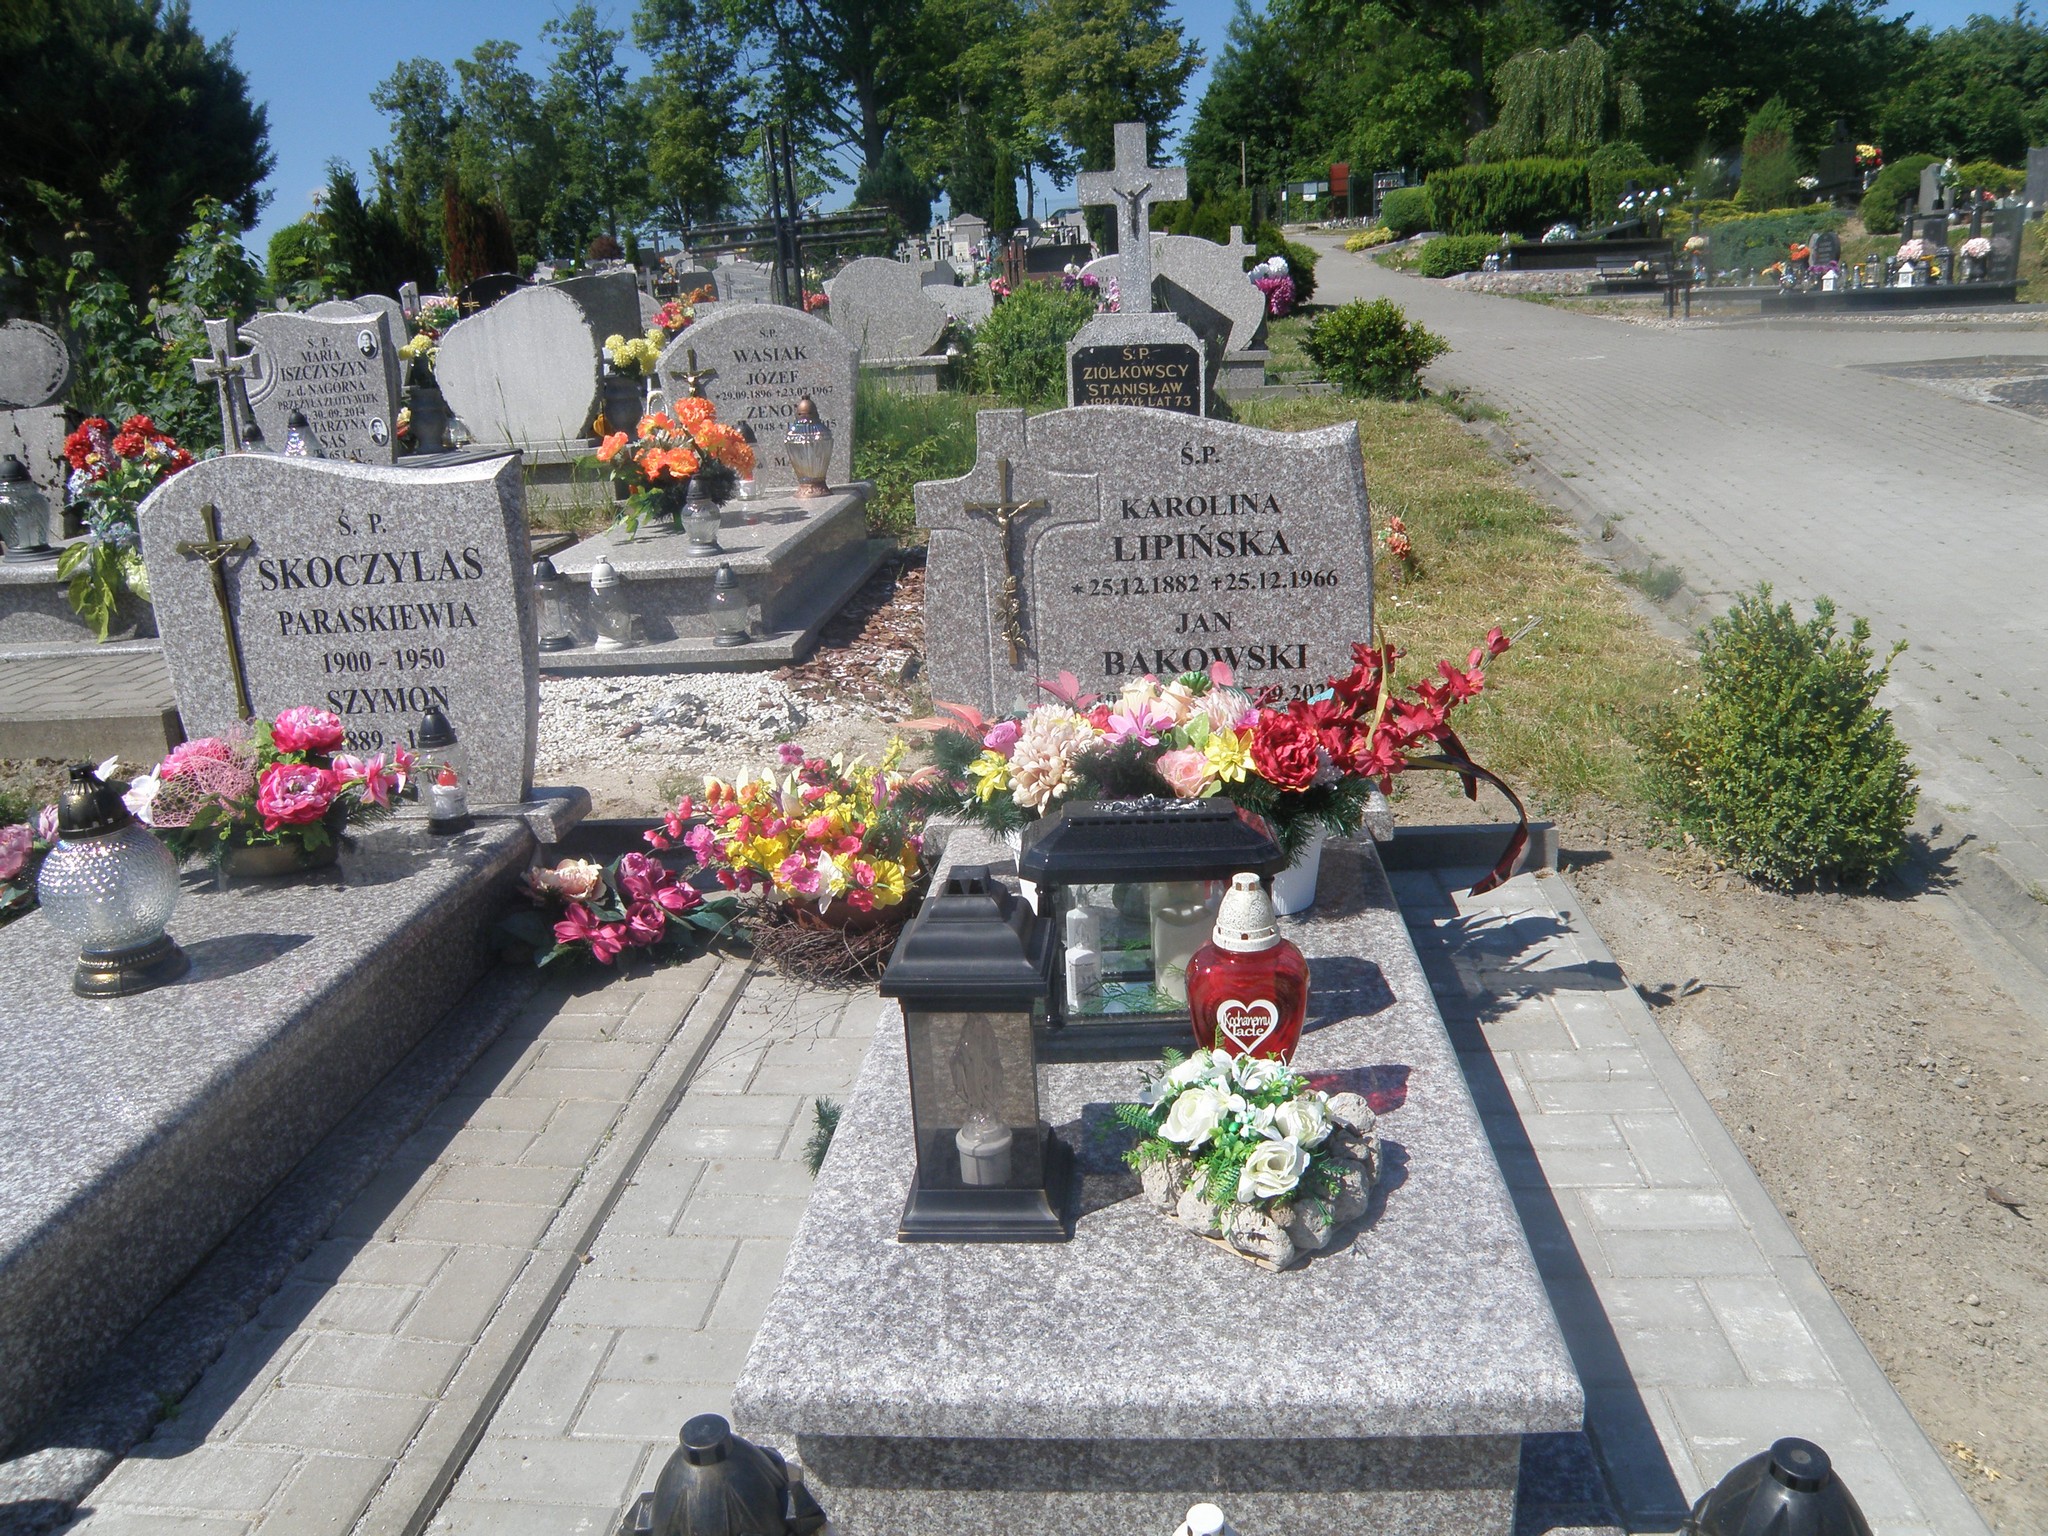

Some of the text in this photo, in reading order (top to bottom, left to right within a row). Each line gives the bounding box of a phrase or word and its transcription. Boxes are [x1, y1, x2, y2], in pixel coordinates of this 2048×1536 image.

[301, 350, 341, 363] MARIA
[733, 346, 808, 363] WASIAK
[281, 361, 367, 381] ISZCZYSZYN
[746, 369, 799, 385] JÓZEF
[1083, 363, 1189, 380] ZIÓŁKOWSCY
[297, 385, 306, 397] d.
[308, 379, 366, 395] NAGÓRNA
[1088, 382, 1183, 397] STANISŁAW
[324, 396, 352, 408] ZŁOTY
[353, 393, 379, 405] WIEK
[1148, 396, 1171, 407] LAT
[1175, 396, 1192, 407] 73
[345, 406, 365, 417] 2014
[746, 404, 799, 420] ZENO
[320, 433, 347, 448] SAS
[329, 450, 340, 460] 65
[342, 448, 364, 459] LAT
[1121, 493, 1281, 520] KAROLINA
[368, 513, 387, 534] P.
[1114, 525, 1292, 562] LIPIŃSKA
[258, 547, 483, 591] SKOCZYLAS
[278, 601, 478, 636] PARASKIEWIA
[1175, 611, 1232, 634] JAN
[322, 651, 372, 674] 1900
[395, 647, 446, 671] 1950
[1104, 644, 1308, 677] BAKOWSKI
[327, 685, 450, 716] SZYMON
[345, 730, 384, 751] 889
